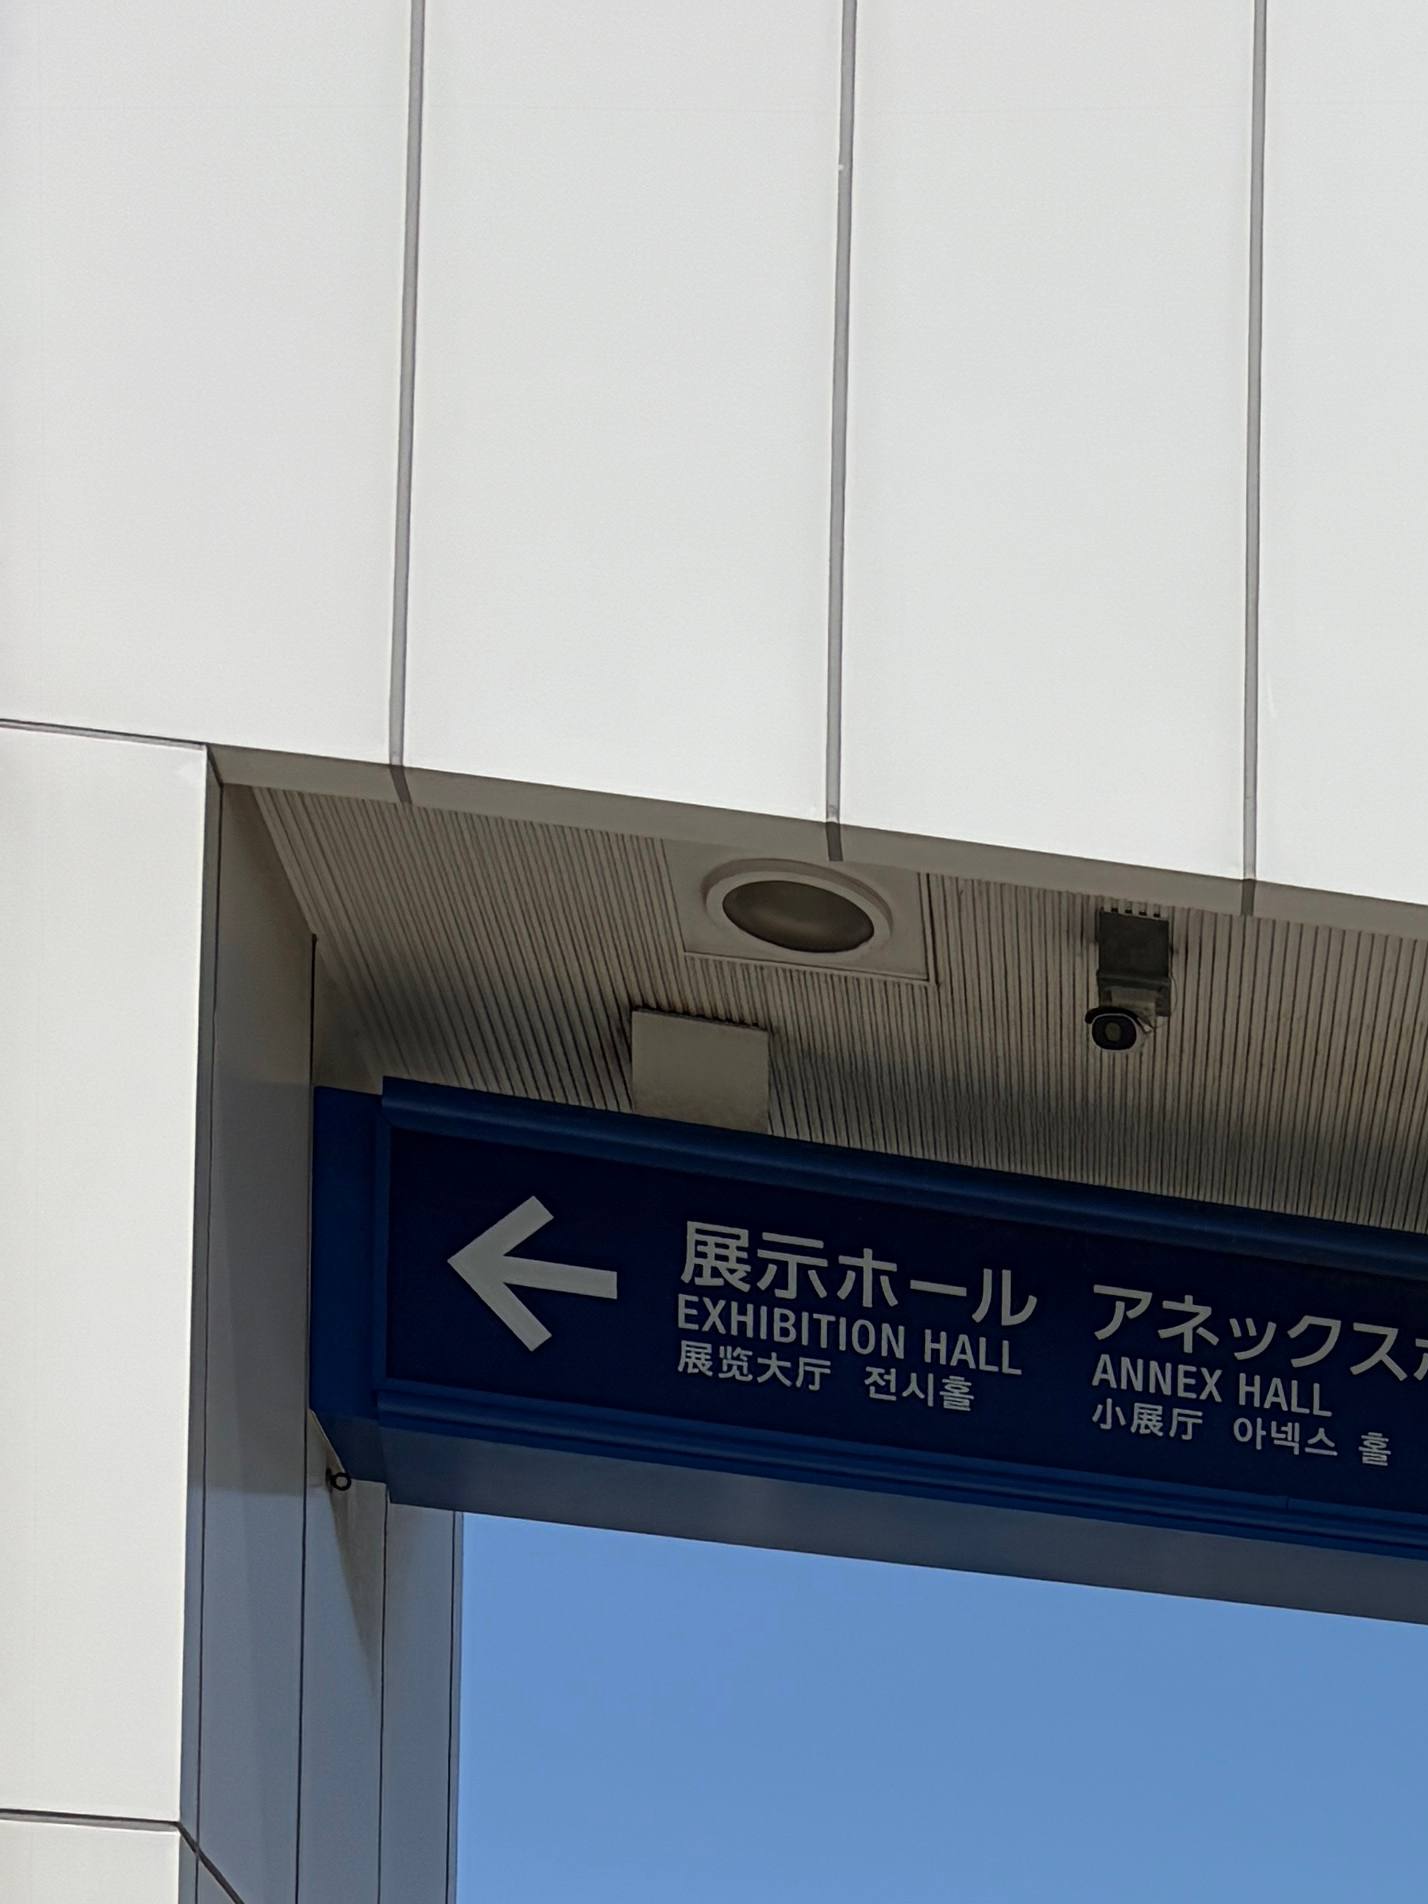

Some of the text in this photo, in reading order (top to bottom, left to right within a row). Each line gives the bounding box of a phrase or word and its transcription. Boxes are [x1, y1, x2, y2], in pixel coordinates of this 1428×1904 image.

[681, 1221, 1037, 1326] 展示ホール
[678, 1294, 1022, 1375] EXHIBITION HALL
[678, 1341, 974, 1411] 展览大厅 전시홀
[1092, 1354, 1332, 1417] ANNEX HALL
[1092, 1398, 1391, 1466] 小展厅 아넥스 홀
